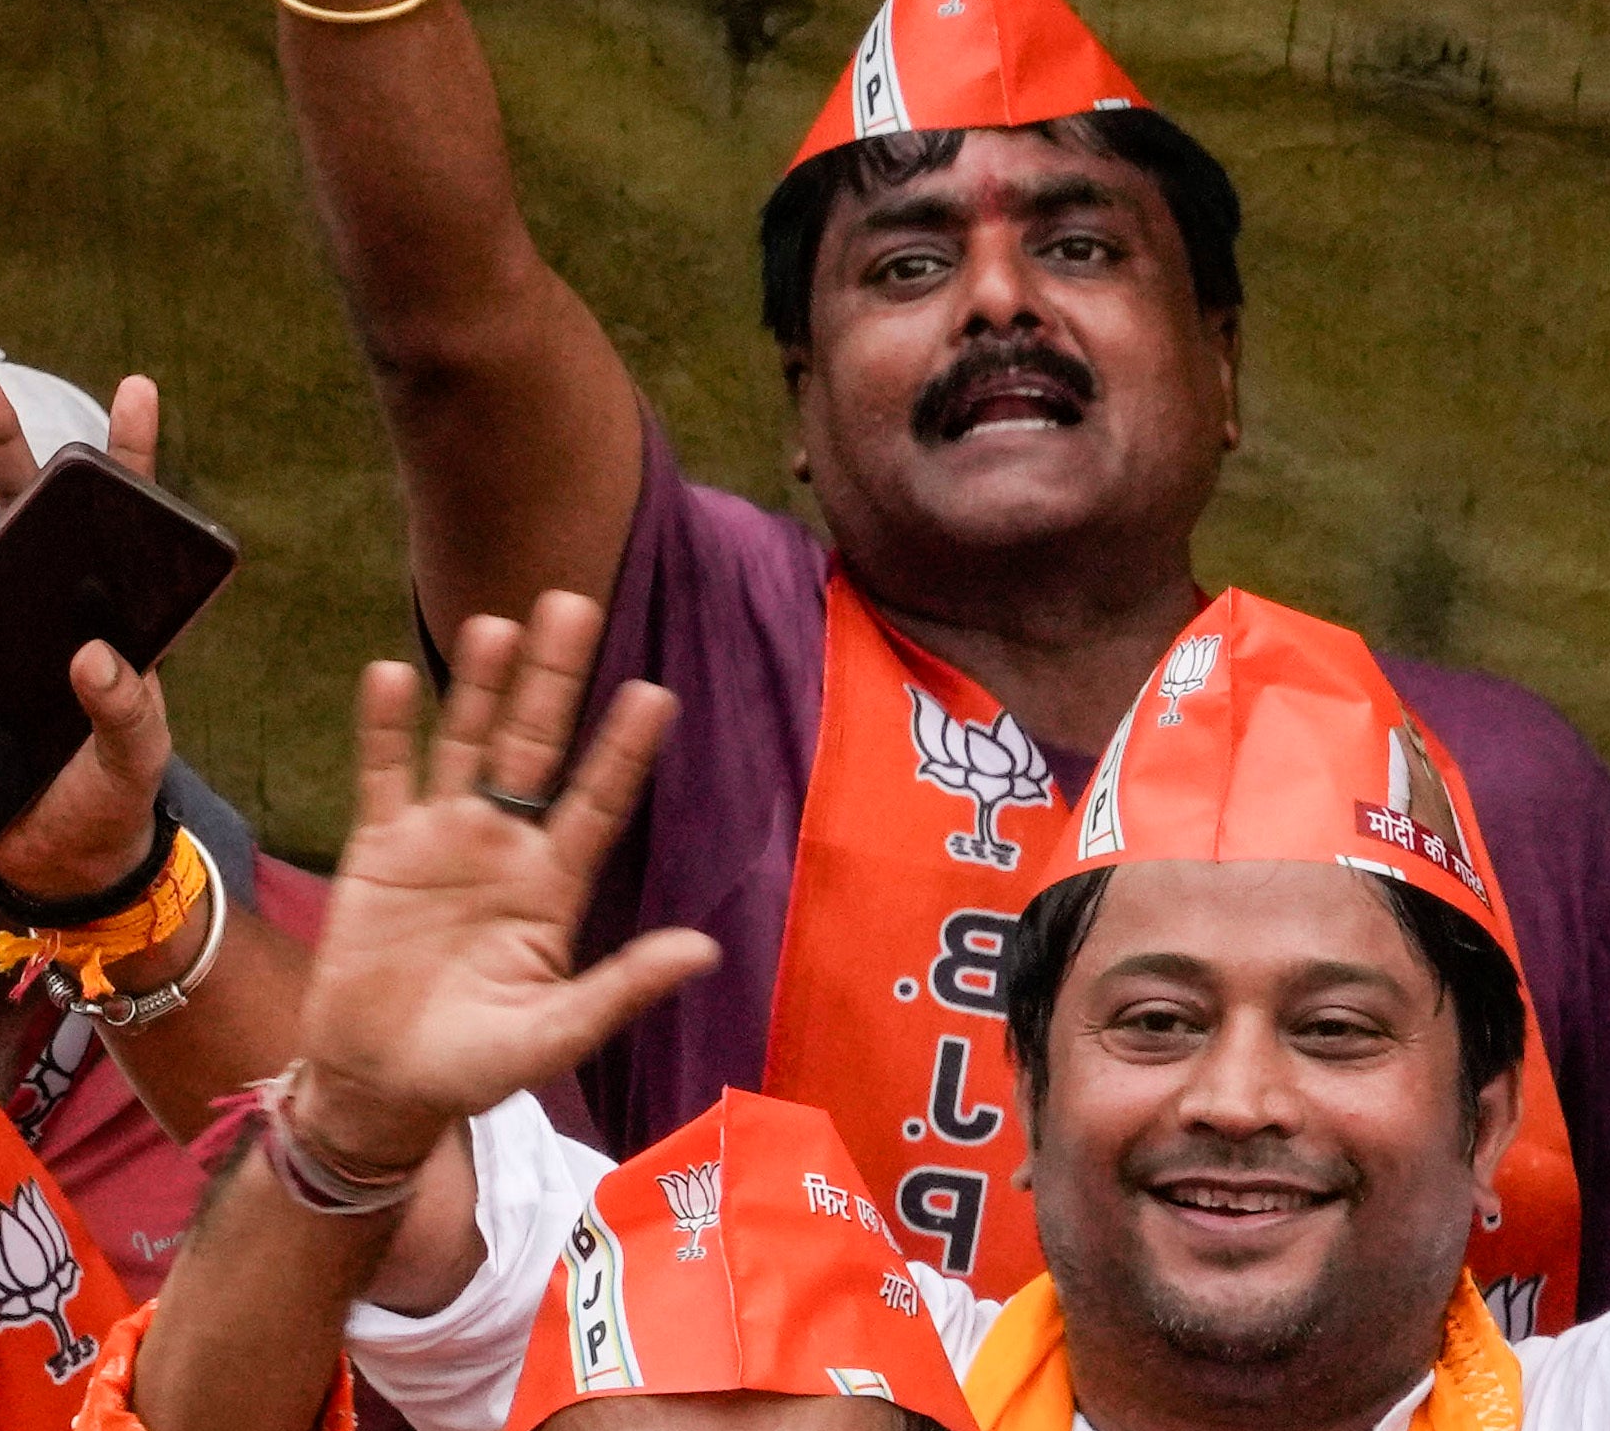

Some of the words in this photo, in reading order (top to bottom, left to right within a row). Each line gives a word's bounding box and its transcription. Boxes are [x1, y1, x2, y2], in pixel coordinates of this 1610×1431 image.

[1366, 807, 1415, 850] मोदी
[1421, 833, 1448, 869] की
[802, 1172, 852, 1220] फिर
